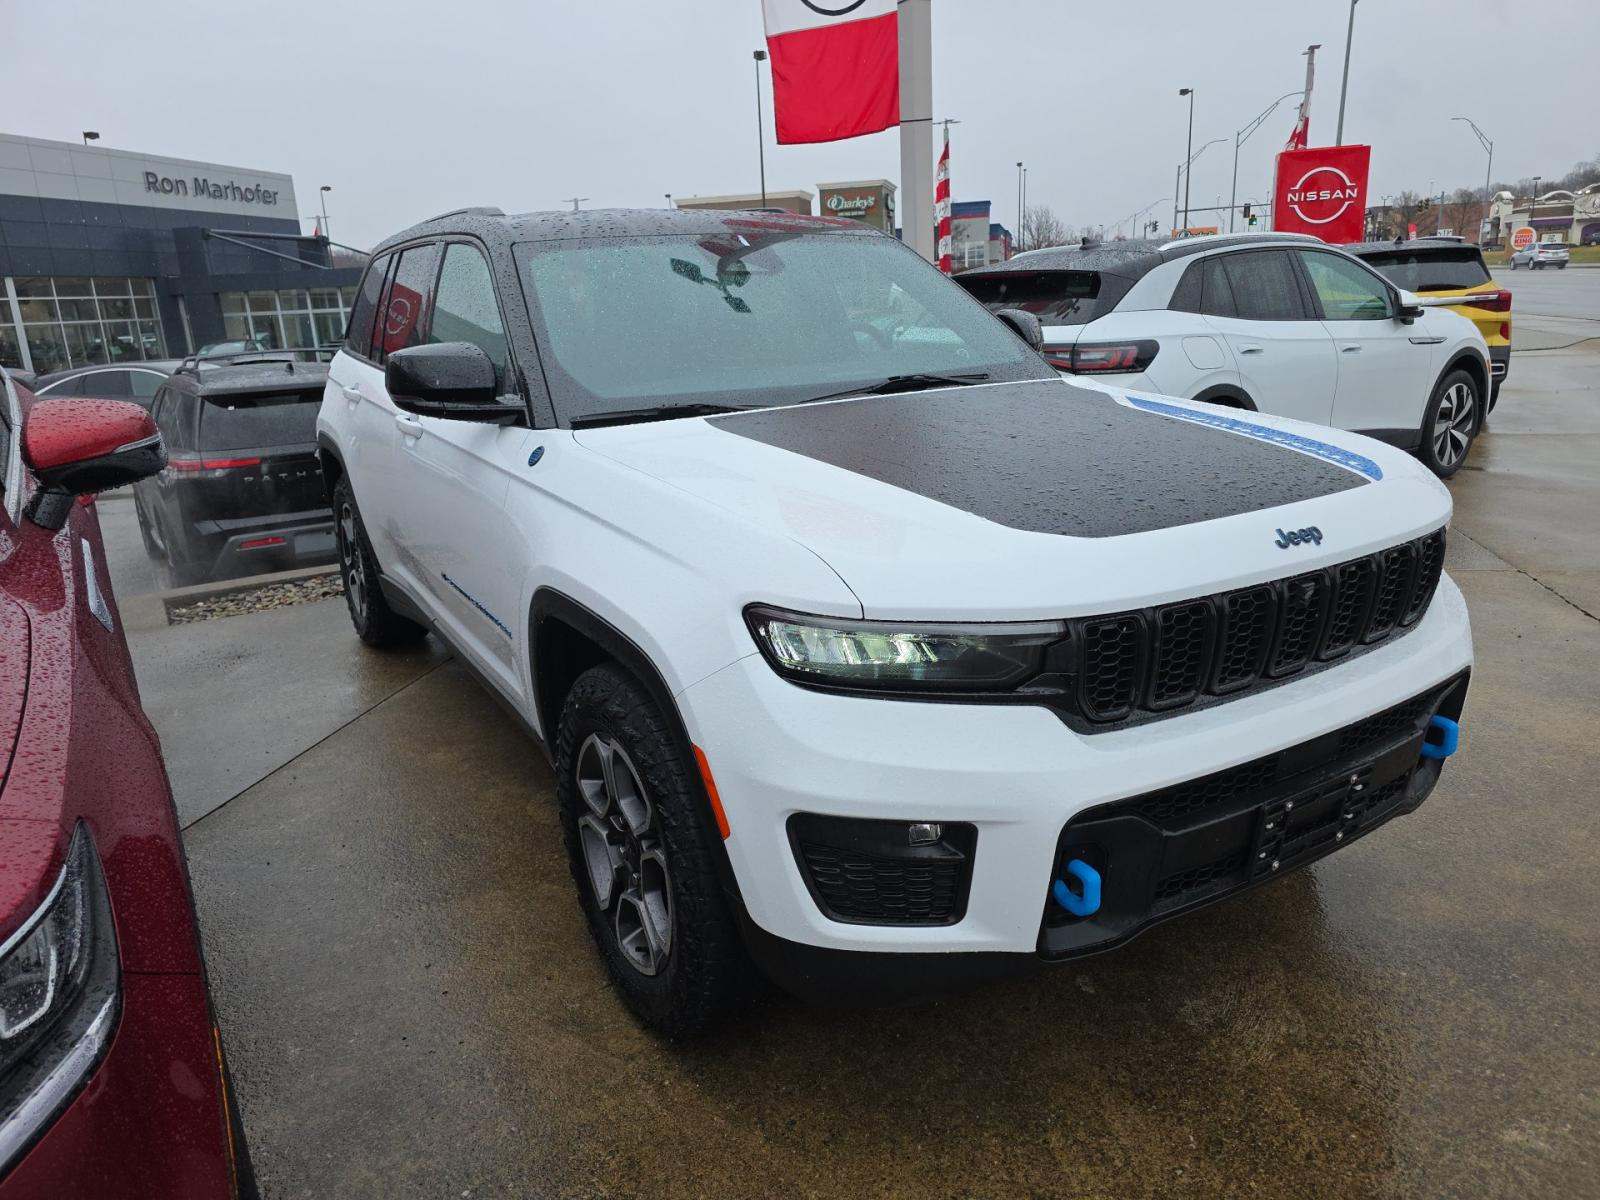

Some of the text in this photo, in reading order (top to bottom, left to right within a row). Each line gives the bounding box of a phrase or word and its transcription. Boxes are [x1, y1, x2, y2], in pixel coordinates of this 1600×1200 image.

[144, 171, 278, 205] Ron Marhofer
[1287, 188, 1358, 202] NISSAN
[1275, 526, 1323, 549] Jeep
